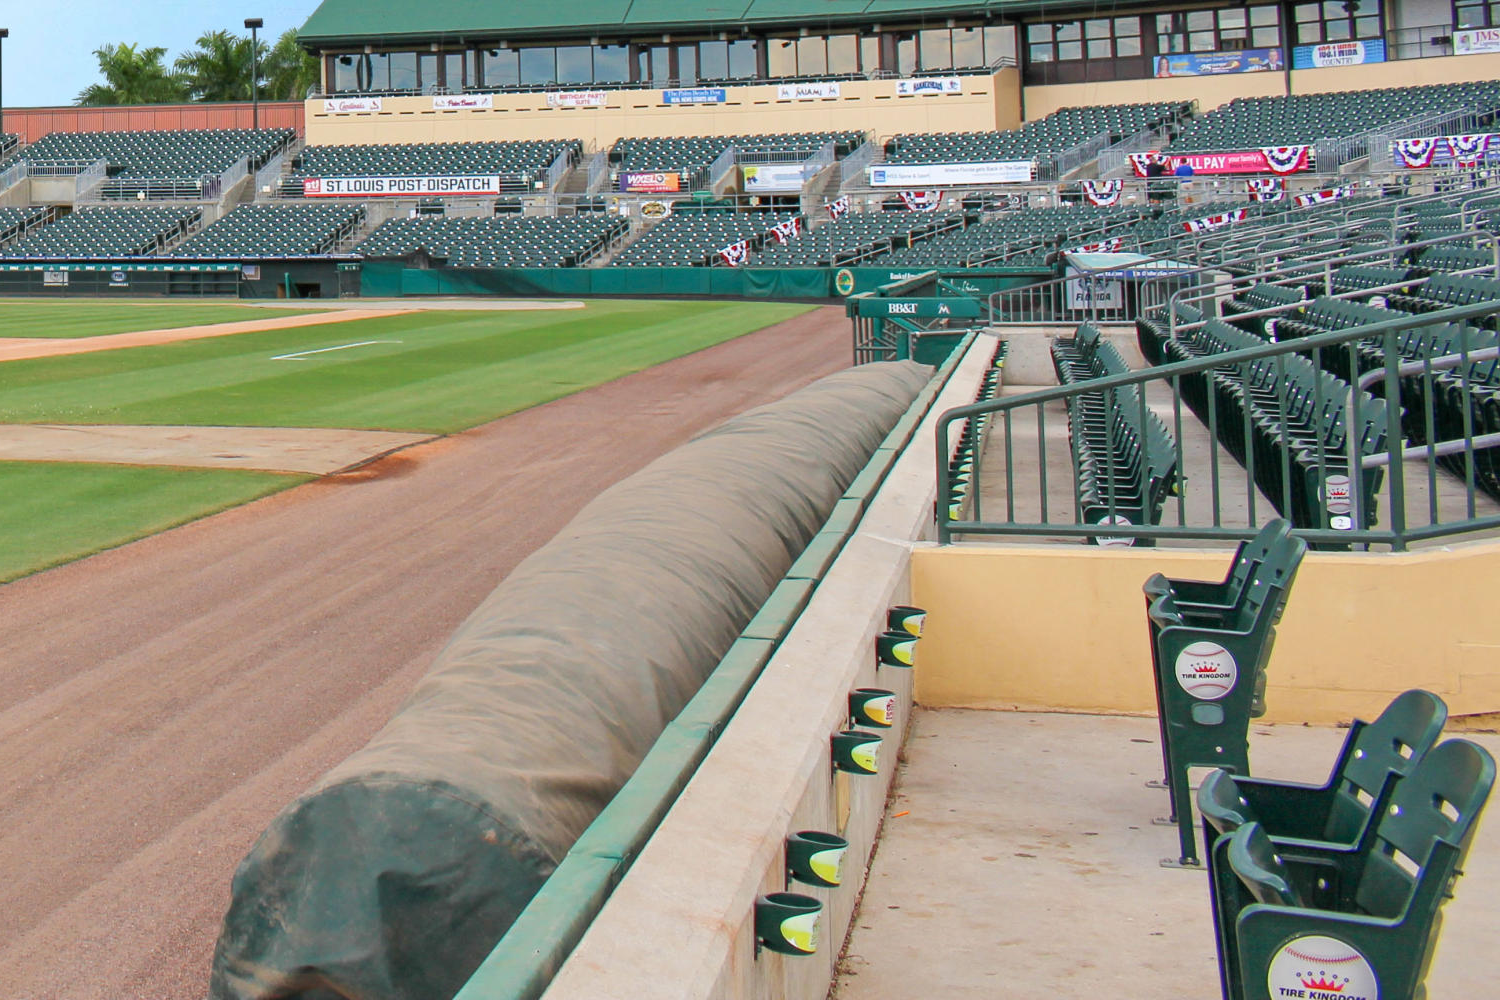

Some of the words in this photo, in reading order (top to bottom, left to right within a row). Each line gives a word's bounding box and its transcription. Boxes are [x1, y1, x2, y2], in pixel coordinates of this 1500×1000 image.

[1203, 156, 1226, 169] PAY
[326, 180, 344, 192] ST.
[346, 179, 384, 192] LOUIS
[388, 177, 491, 192] POST-DISPATCH
[888, 302, 918, 314] BB&T
[1279, 987, 1306, 999] TIRE
